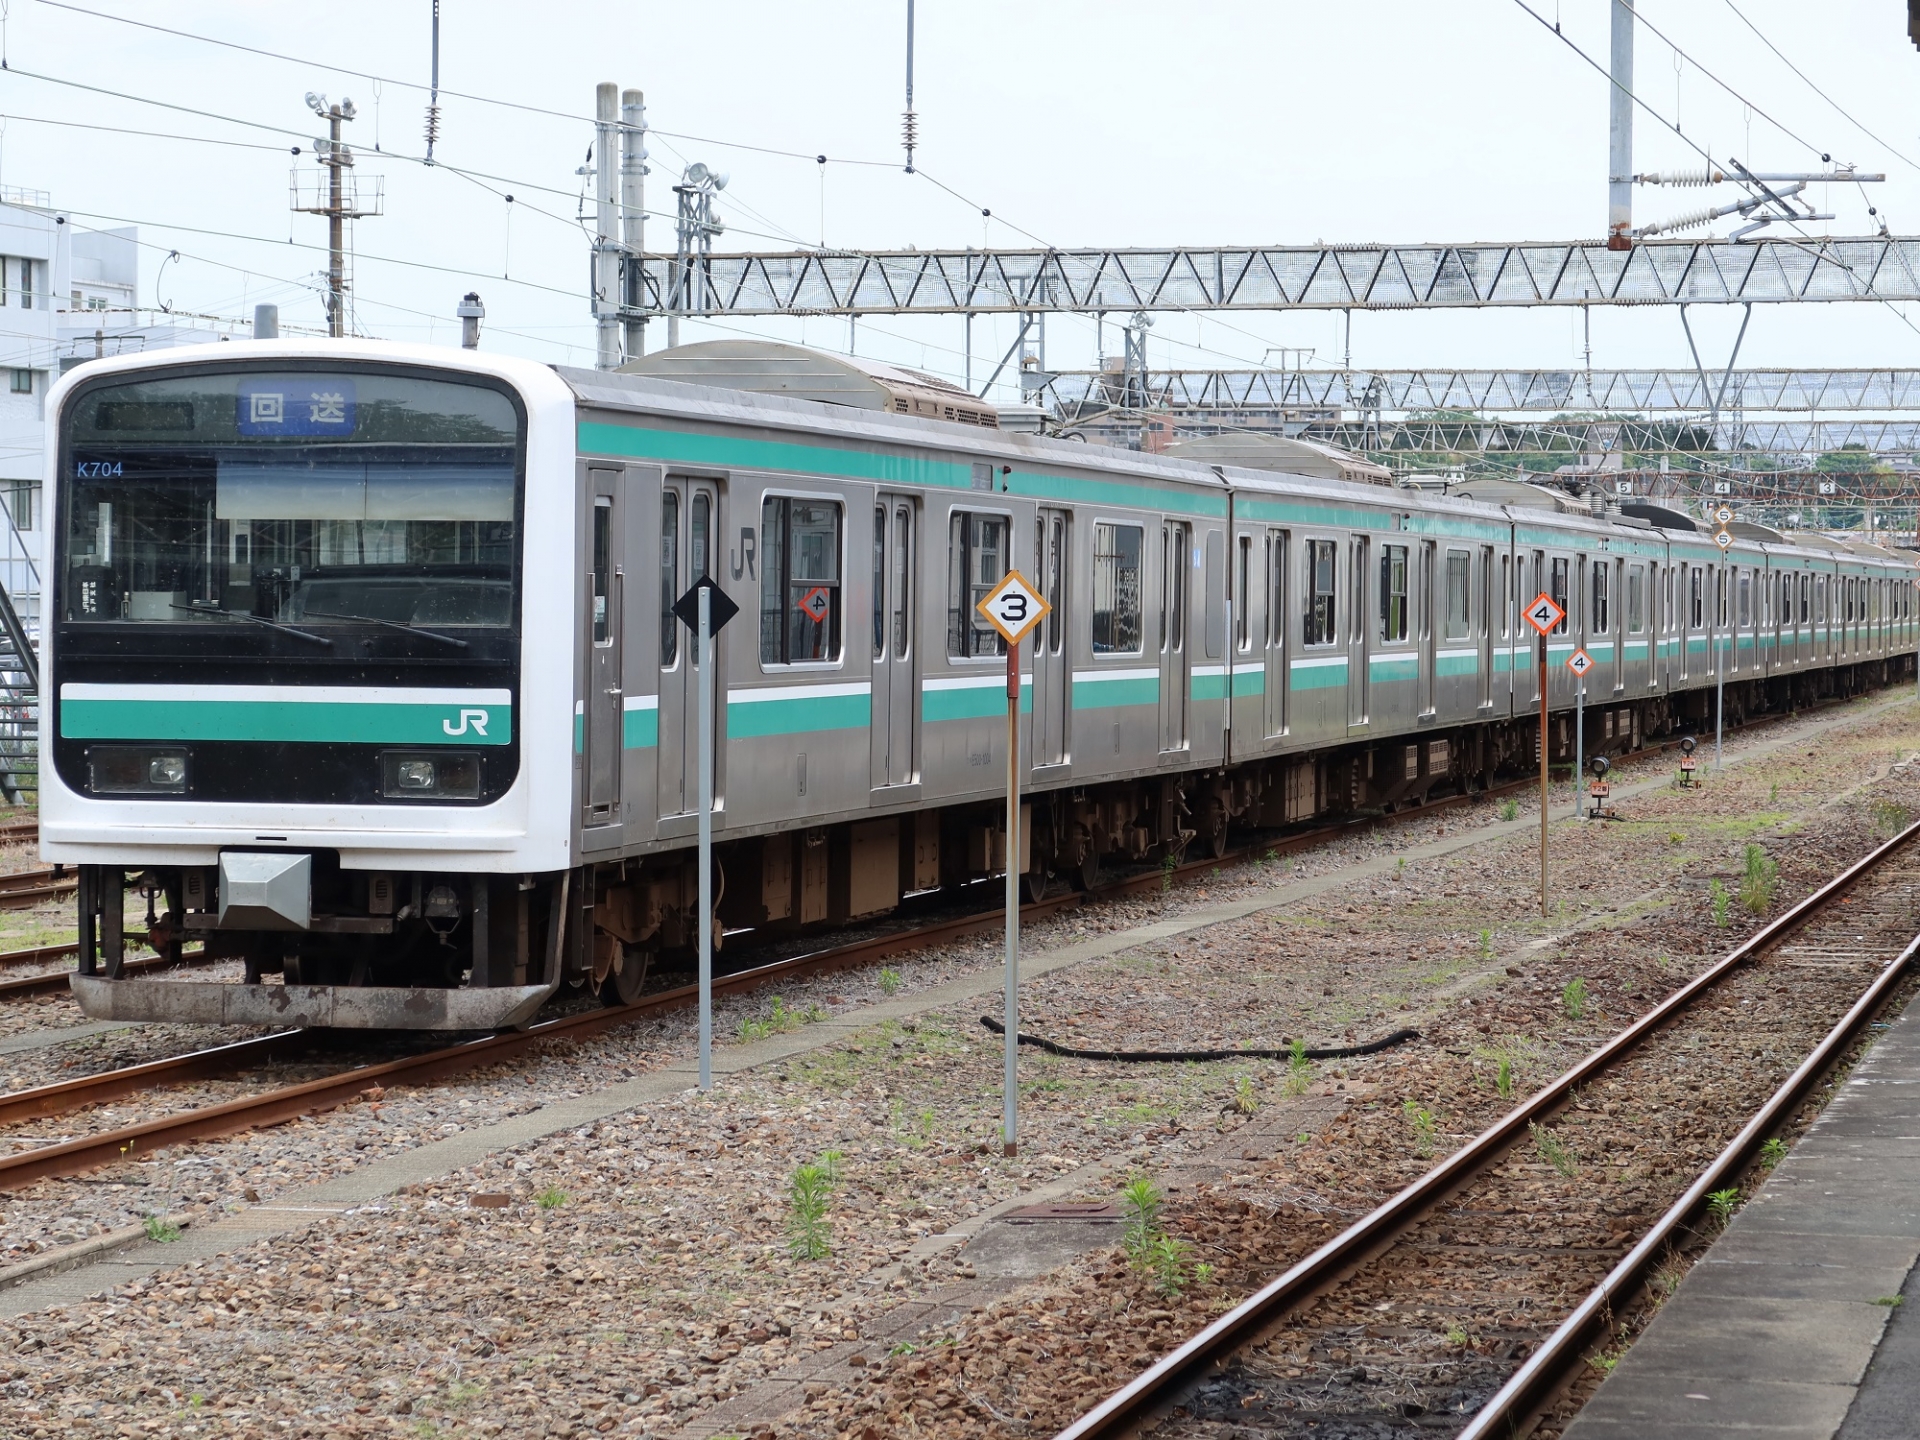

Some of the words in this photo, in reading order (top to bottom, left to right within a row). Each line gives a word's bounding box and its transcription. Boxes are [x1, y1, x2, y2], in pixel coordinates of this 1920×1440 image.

[250, 392, 345, 424] 回送
[77, 461, 123, 478] K704
[1620, 482, 1628, 493] 5
[1718, 483, 1726, 493] 4
[1823, 483, 1832, 493] 3
[730, 527, 756, 581] JR
[1000, 594, 1027, 621] 3
[1534, 606, 1550, 622] 4
[1574, 657, 1586, 668] 4
[443, 709, 489, 736] JR
